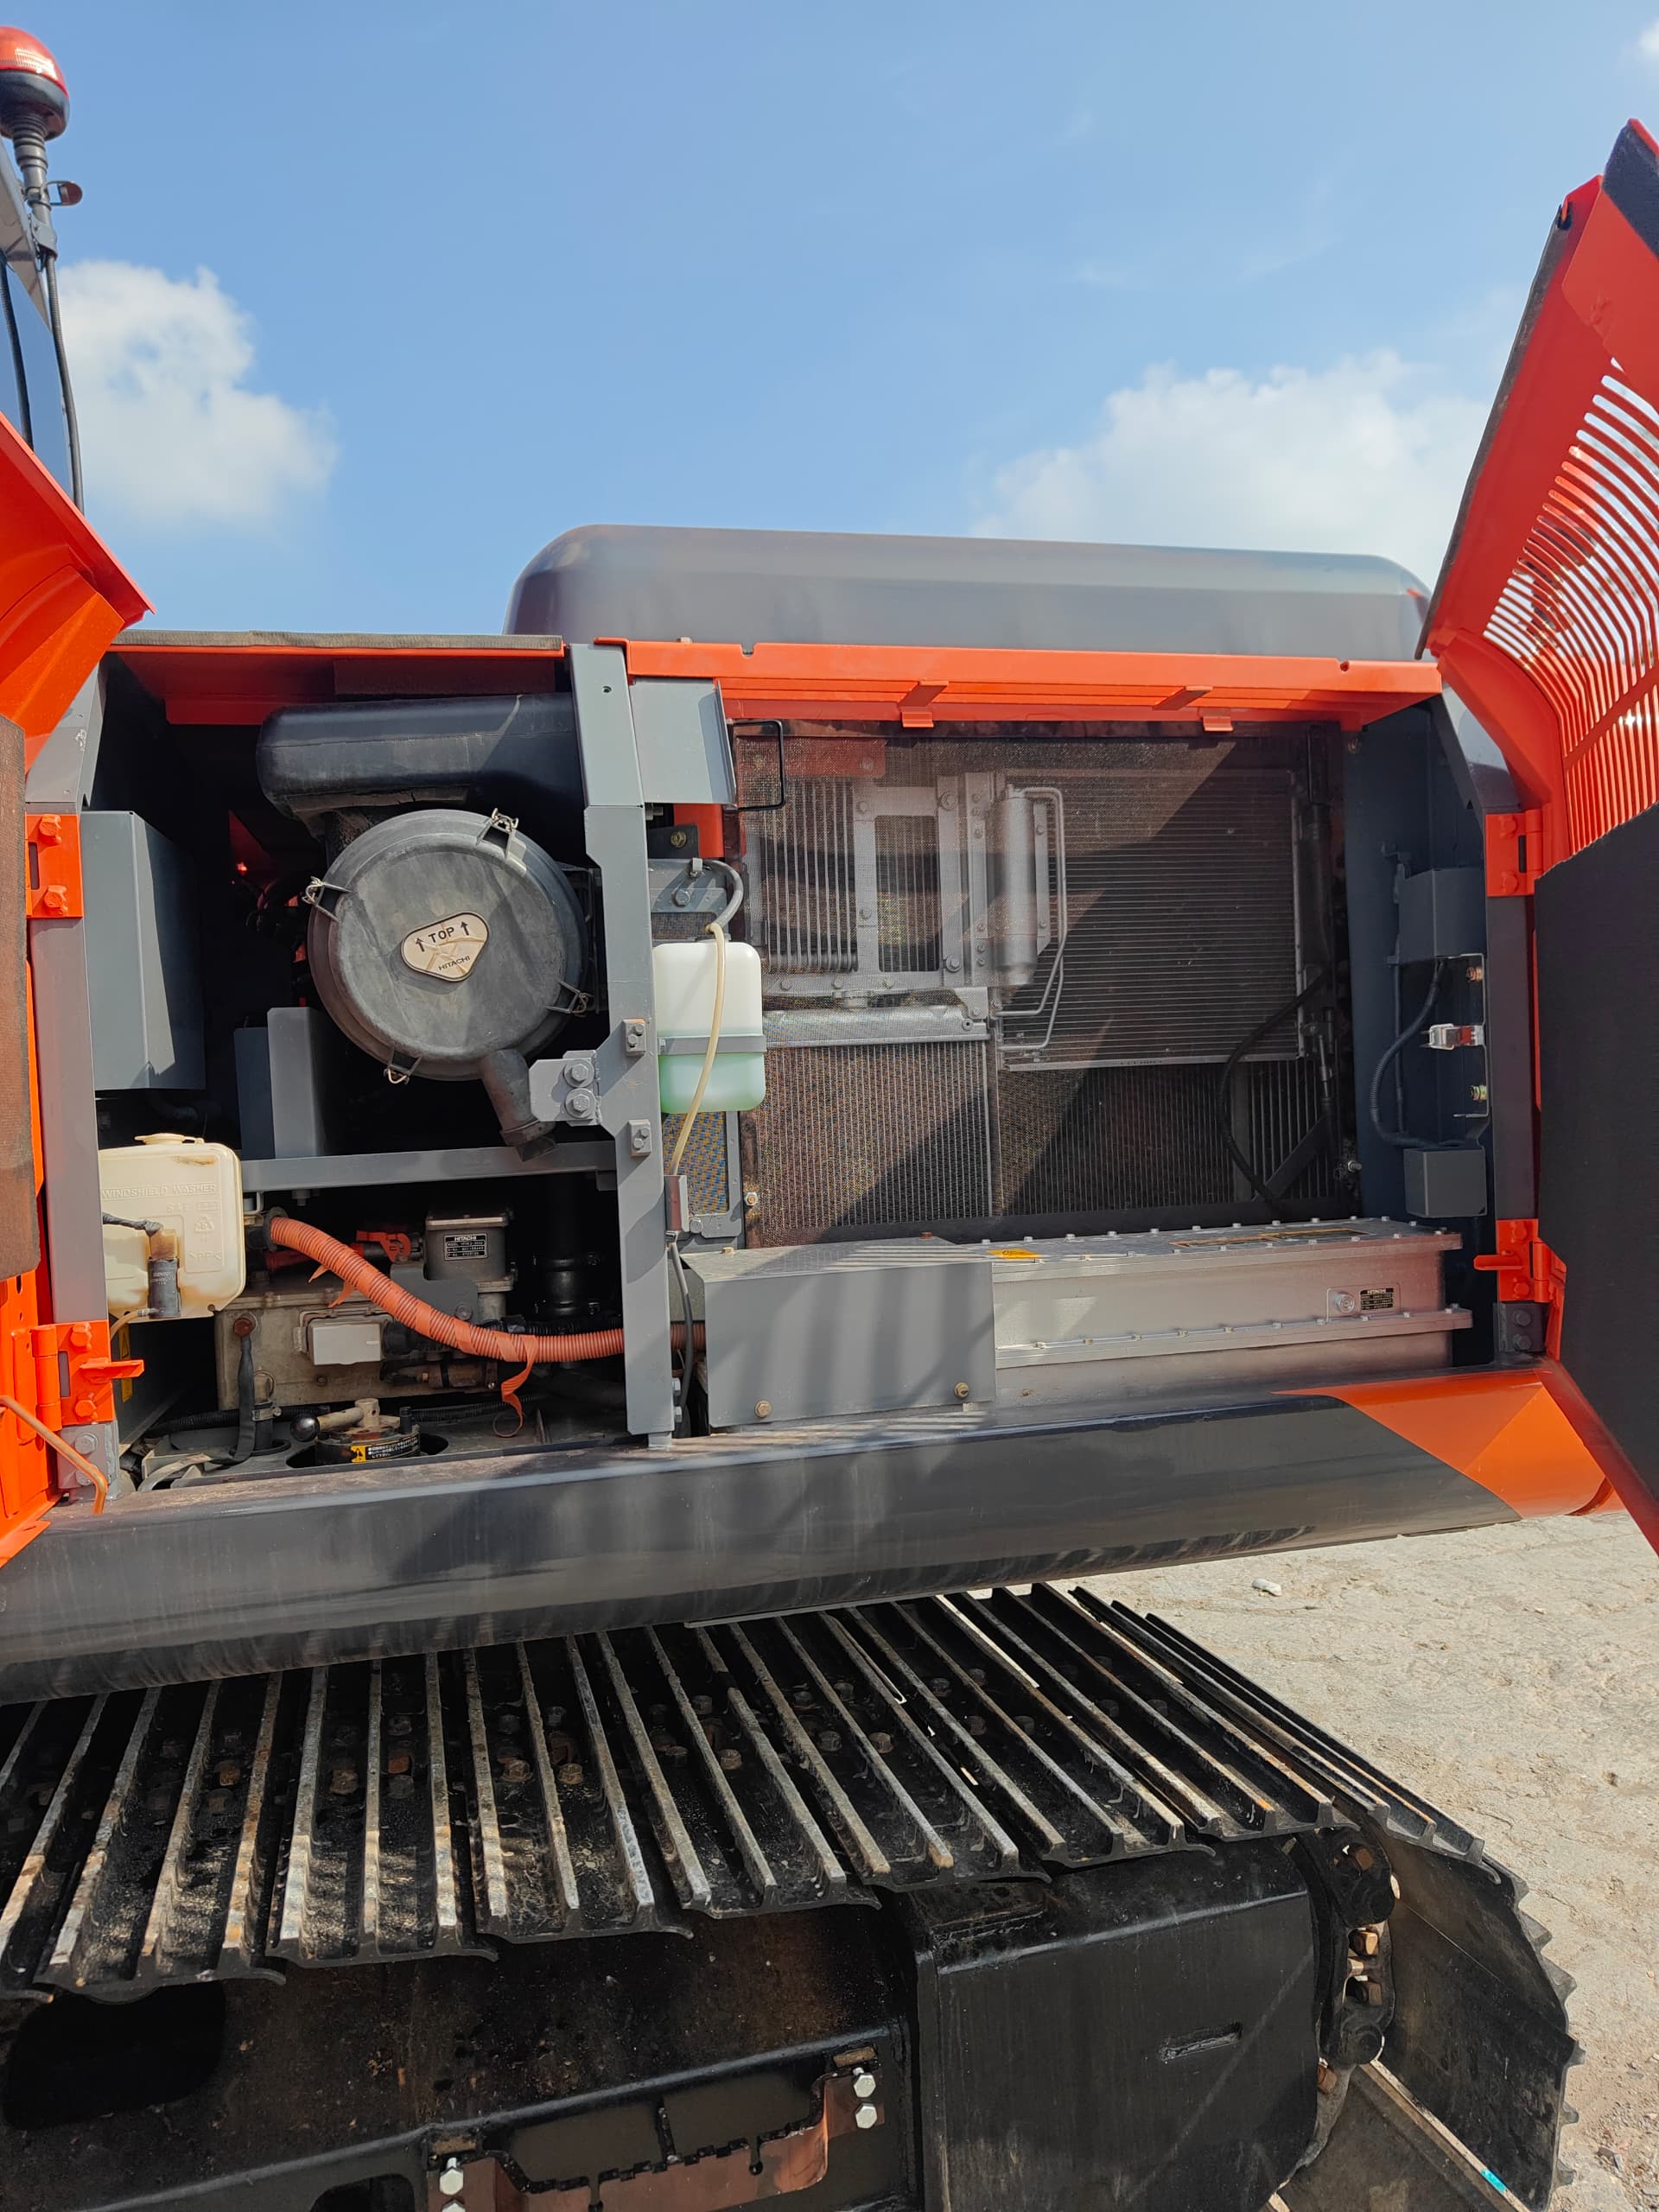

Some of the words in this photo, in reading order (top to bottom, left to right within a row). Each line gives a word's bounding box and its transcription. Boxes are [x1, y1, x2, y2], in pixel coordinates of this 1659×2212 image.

[429, 926, 454, 944] TOP
[438, 956, 470, 970] HITACHI
[102, 1186, 168, 1199] WINDSHIELD
[173, 1183, 216, 1196] WASHER
